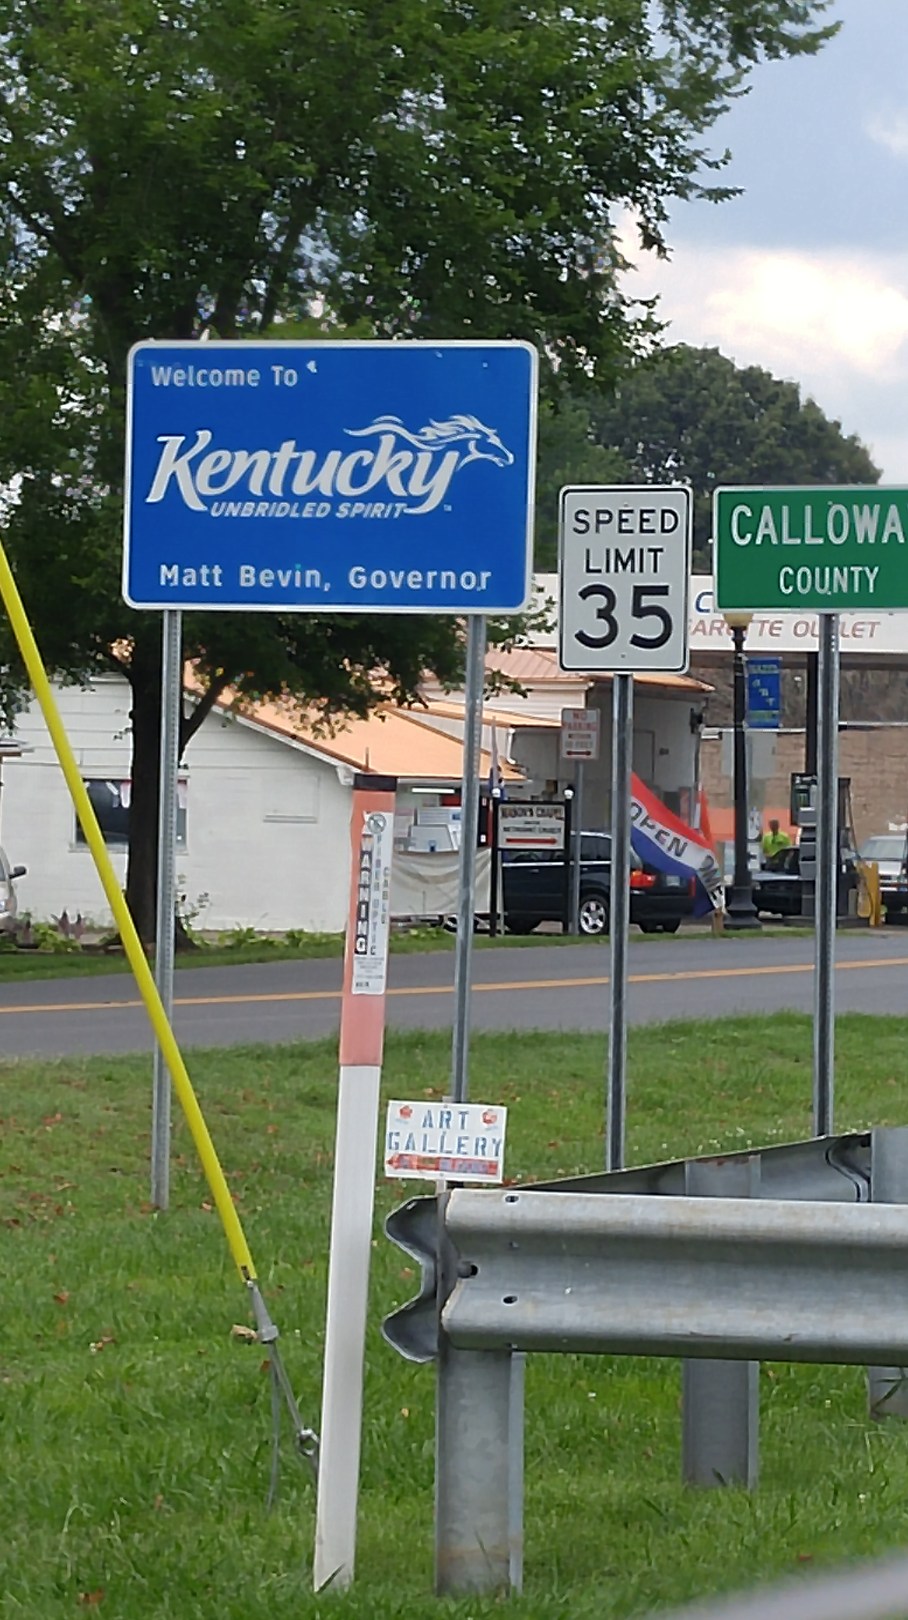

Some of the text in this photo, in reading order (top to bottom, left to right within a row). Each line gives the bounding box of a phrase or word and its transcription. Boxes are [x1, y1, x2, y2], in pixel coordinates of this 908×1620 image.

[151, 365, 298, 387] Welcome To
[145, 429, 460, 514] Kentucky
[210, 501, 405, 520] UNBRIDLED SPIRIT
[572, 508, 679, 535] SPEED
[730, 503, 908, 546] CALLOWA
[585, 547, 664, 574] LIMIT
[159, 564, 492, 592] Matt Bevin, Governor
[779, 565, 880, 595] COUNTY
[574, 583, 673, 650] 35
[792, 619, 881, 638] OULET
[421, 1109, 470, 1130] ART
[388, 1131, 503, 1157] GALLERY
